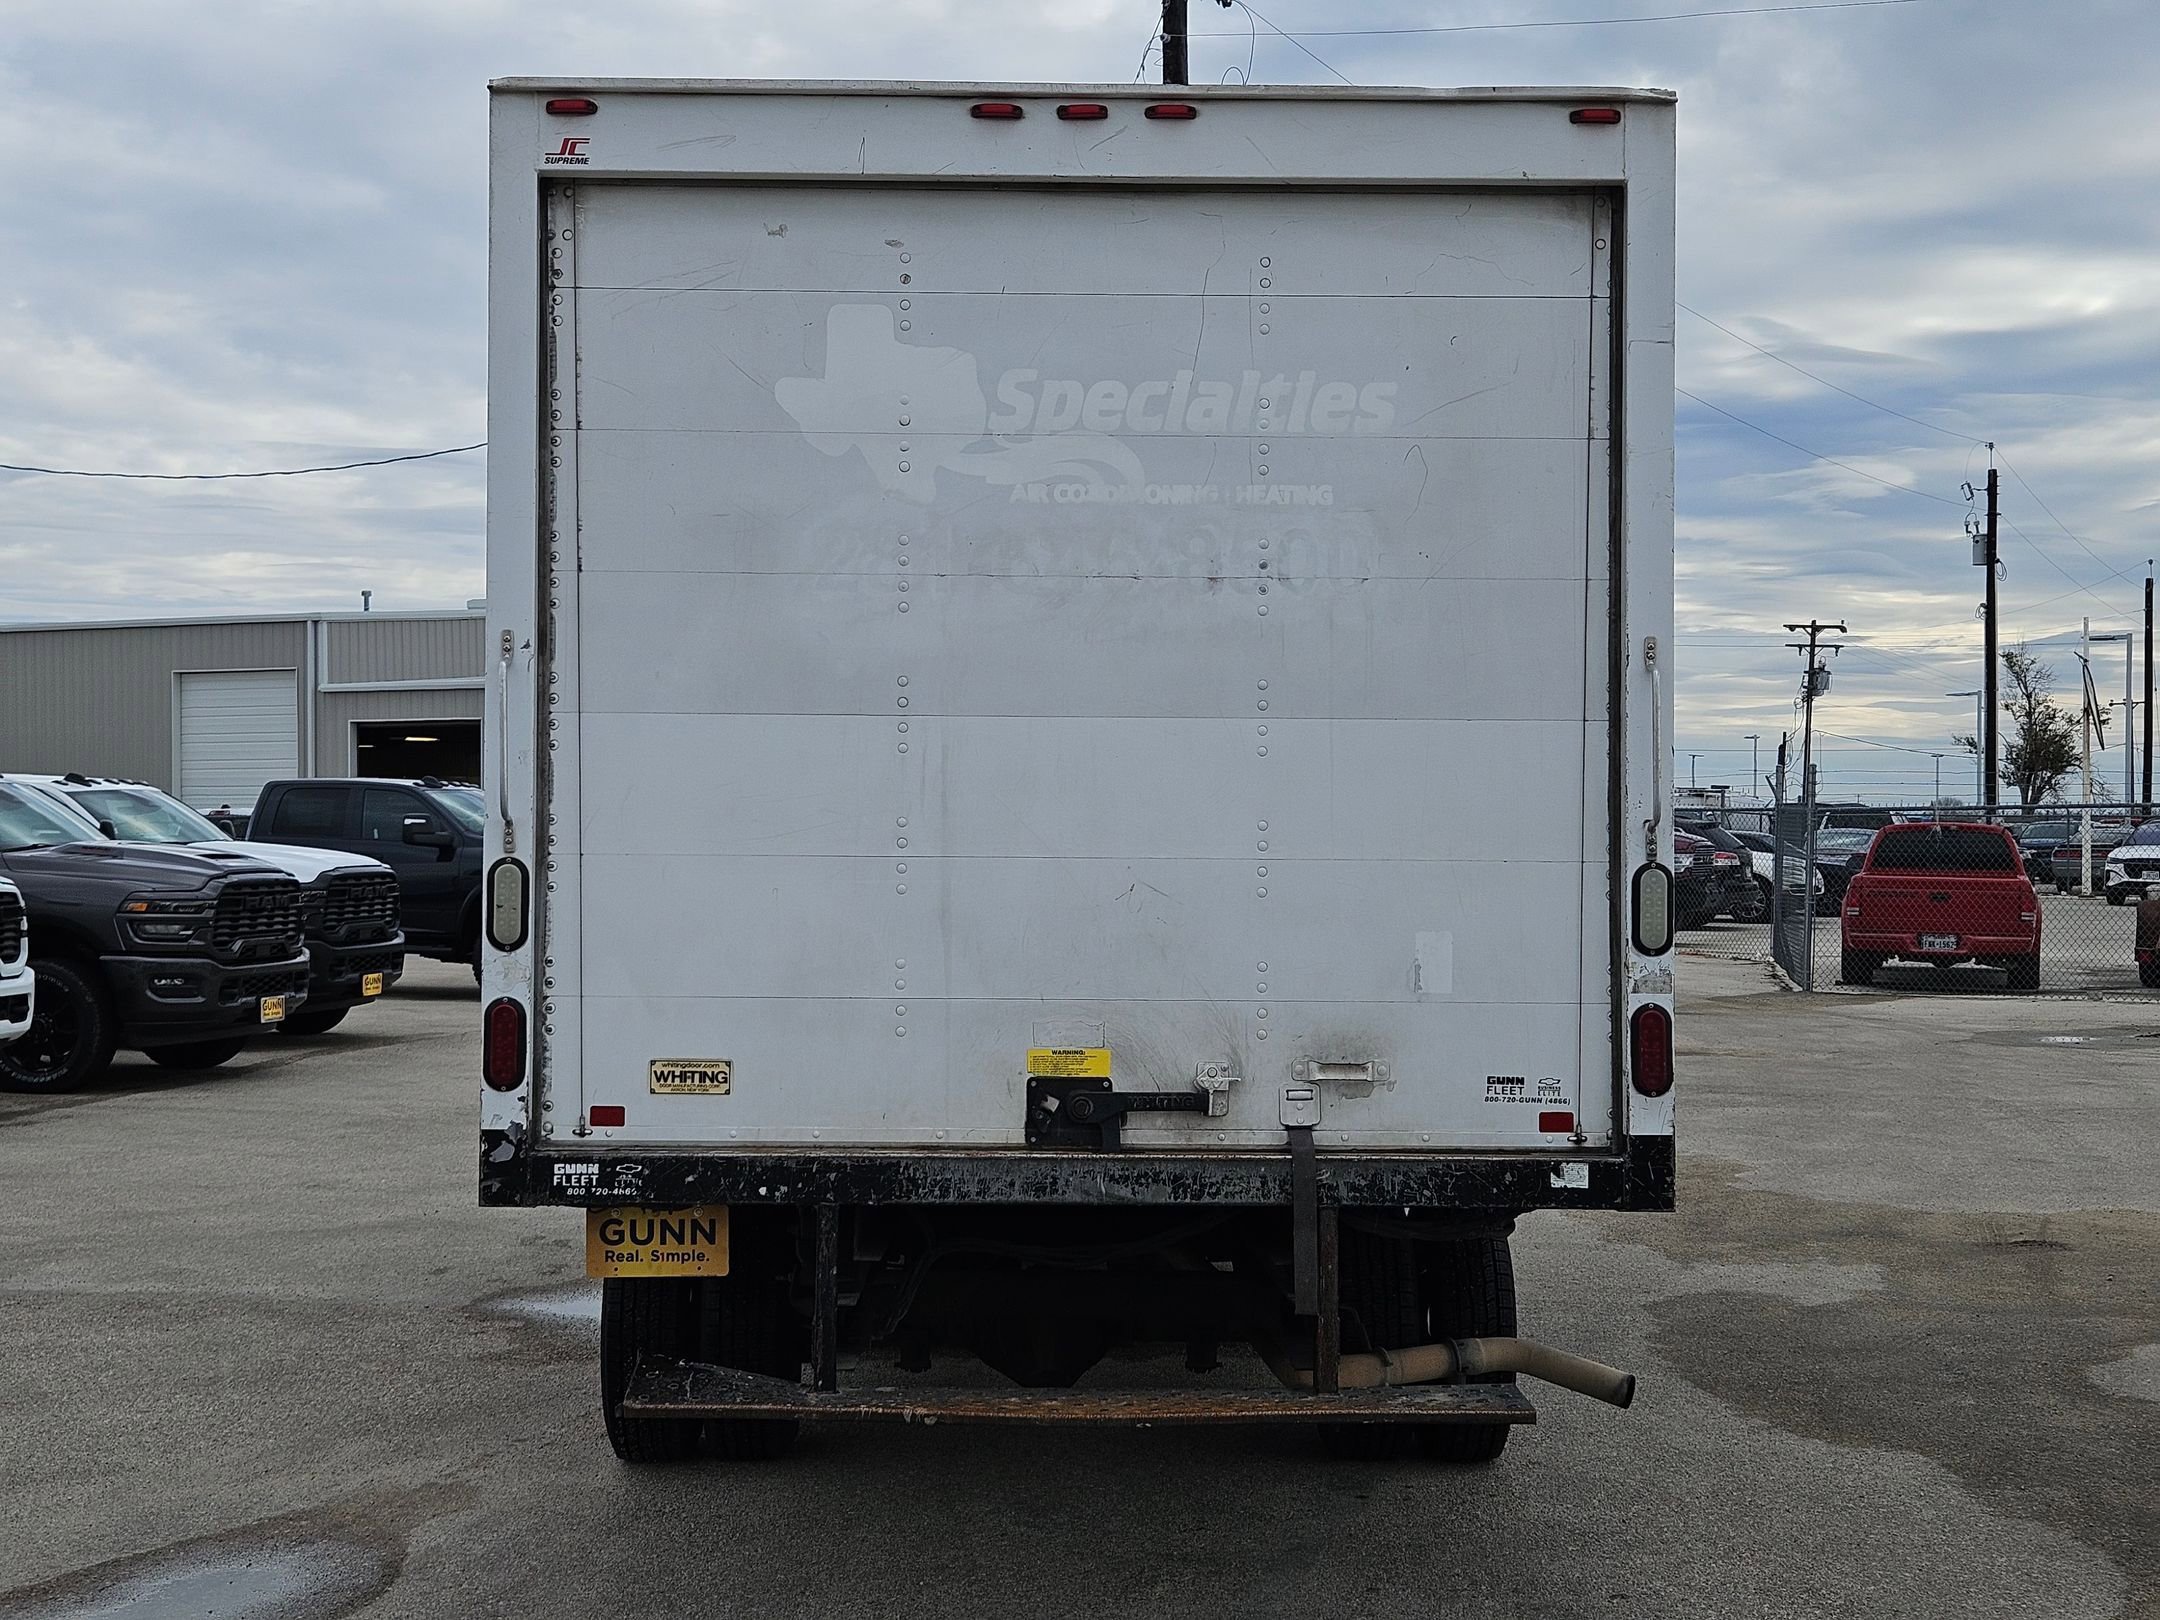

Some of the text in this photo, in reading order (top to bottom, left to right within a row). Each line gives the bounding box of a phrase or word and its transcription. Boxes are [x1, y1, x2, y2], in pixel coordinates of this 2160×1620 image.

[544, 157, 590, 165] SUPREME
[1009, 484, 1335, 506] AIR CODIONING HEATING
[262, 999, 282, 1011] GUNN
[653, 1070, 728, 1084] WHITING
[1486, 1076, 1525, 1086] GUNN
[1486, 1086, 1525, 1096] FLEET
[1484, 1096, 1543, 1104] 800-720-GUNN
[553, 1163, 600, 1175] GUNN
[553, 1174, 600, 1187] FLEET
[598, 1217, 717, 1247] GUNN
[604, 1248, 710, 1265] Real. Simple.
